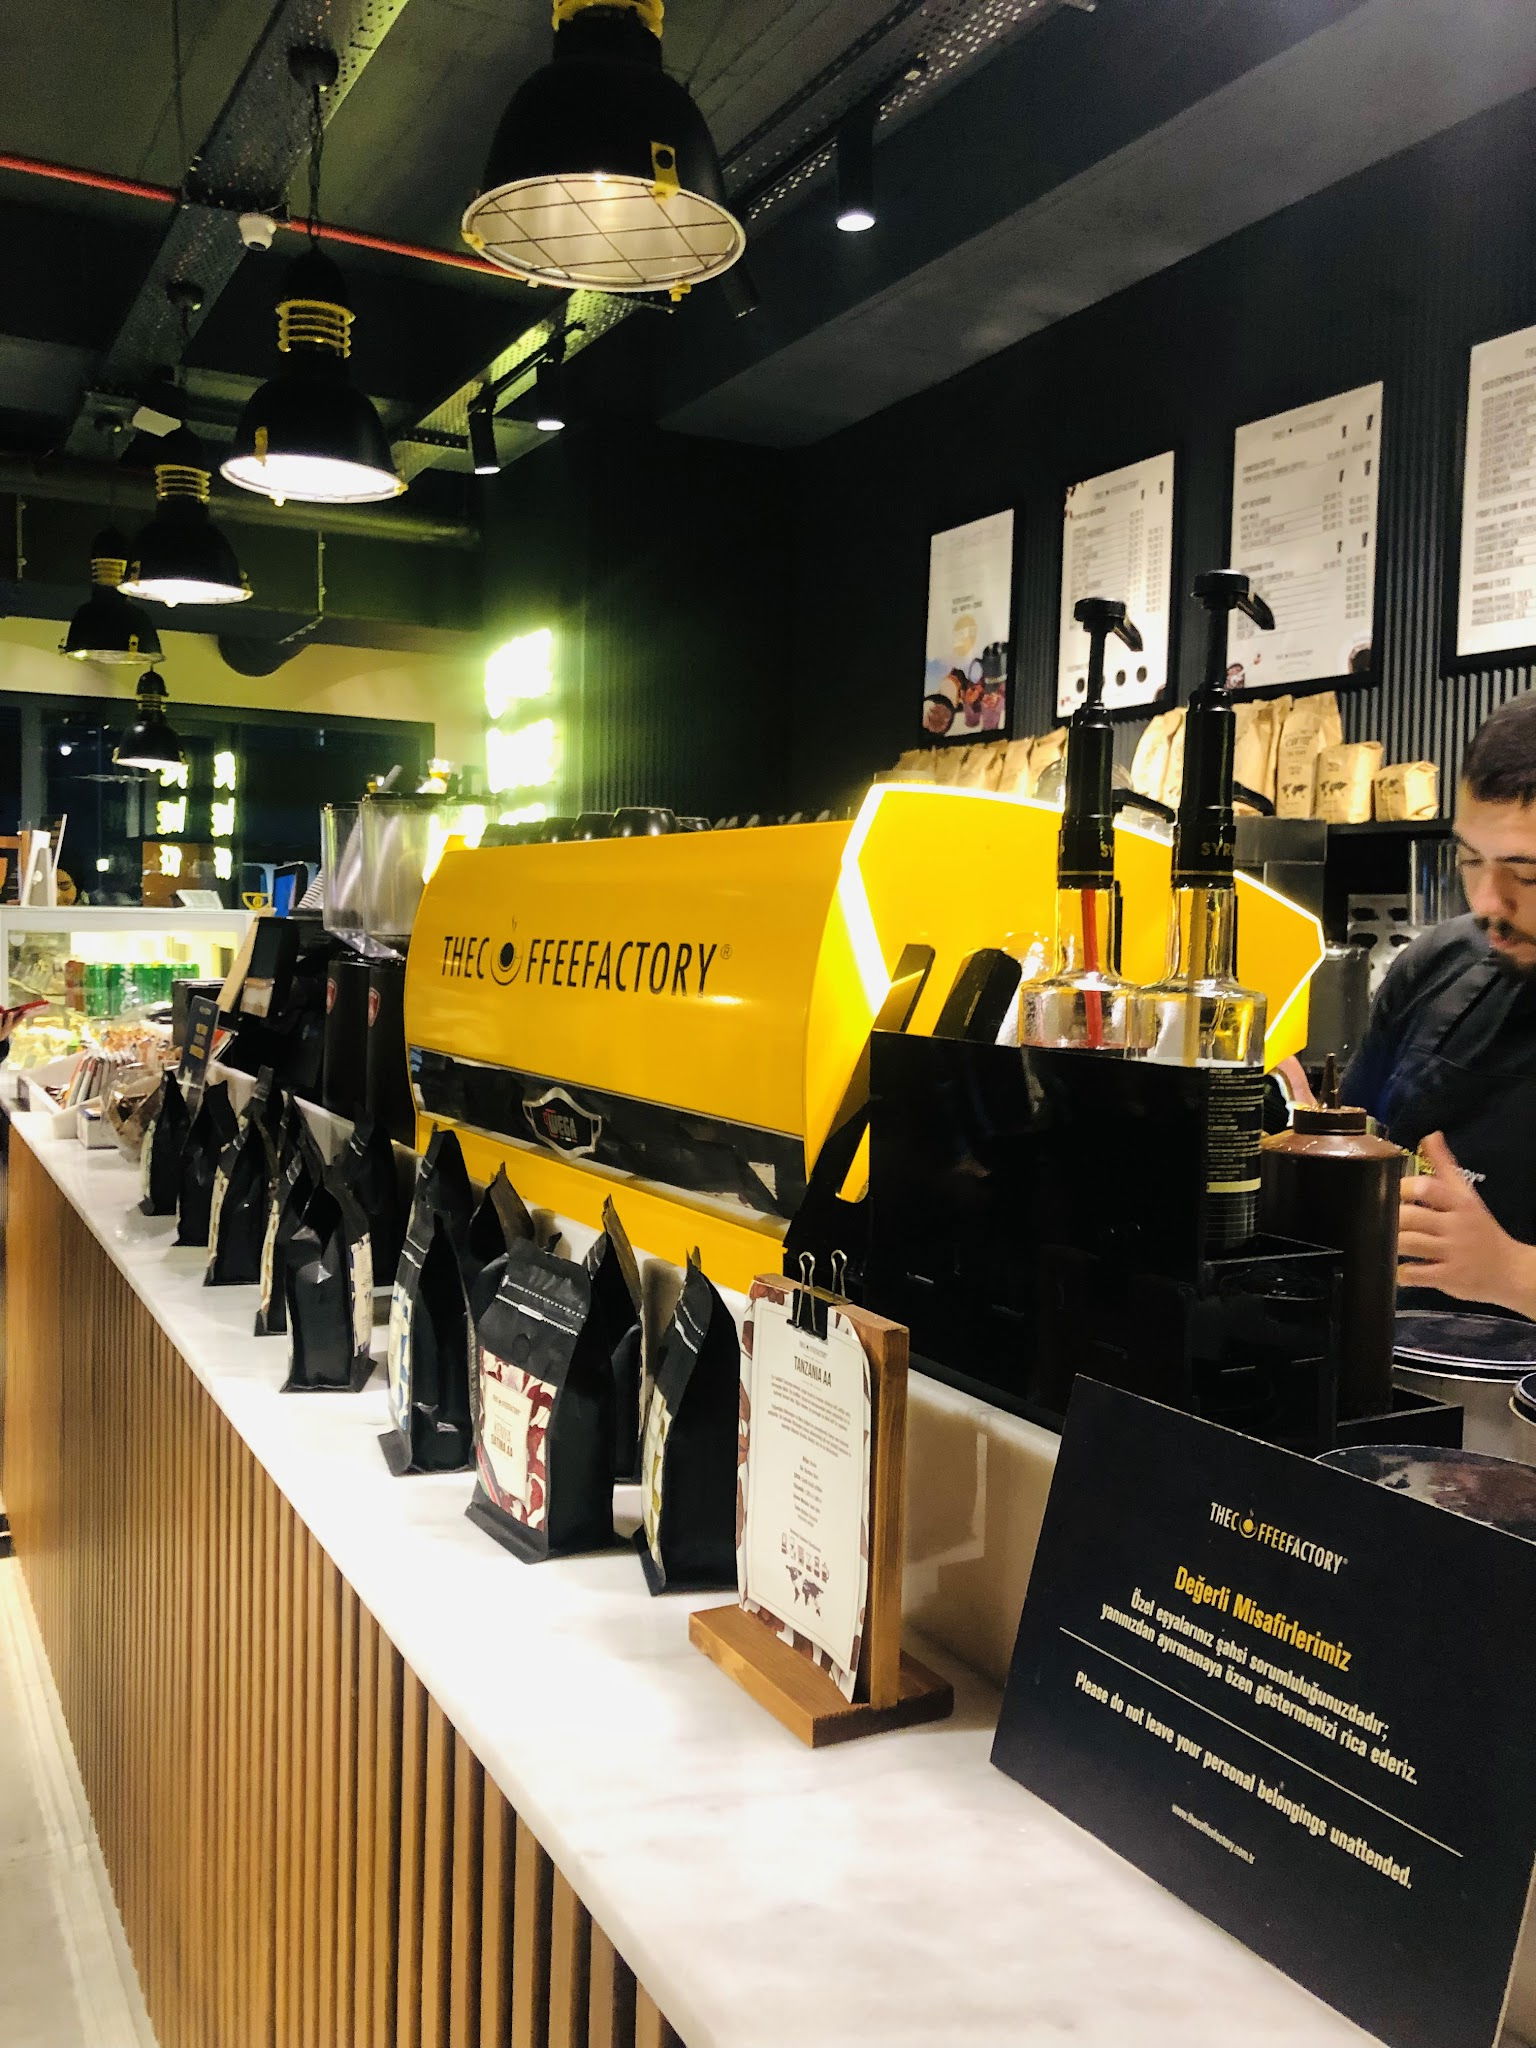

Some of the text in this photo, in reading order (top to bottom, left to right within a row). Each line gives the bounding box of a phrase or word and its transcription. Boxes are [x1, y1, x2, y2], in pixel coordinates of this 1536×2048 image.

[794, 1355, 832, 1388] TANZANIA AA
[1100, 1603, 1418, 1786] yanınızdan ayırmamaya özen göstermenizi rica ederiz.
[1130, 1587, 1389, 1742] Özel eşyalarınız şahsi sorumluluğunuzdadır;
[1174, 1565, 1352, 1672] Değerli Misafirlerimiz
[1075, 1670, 1413, 1890] Please do not leave your personal belongings unattended.
